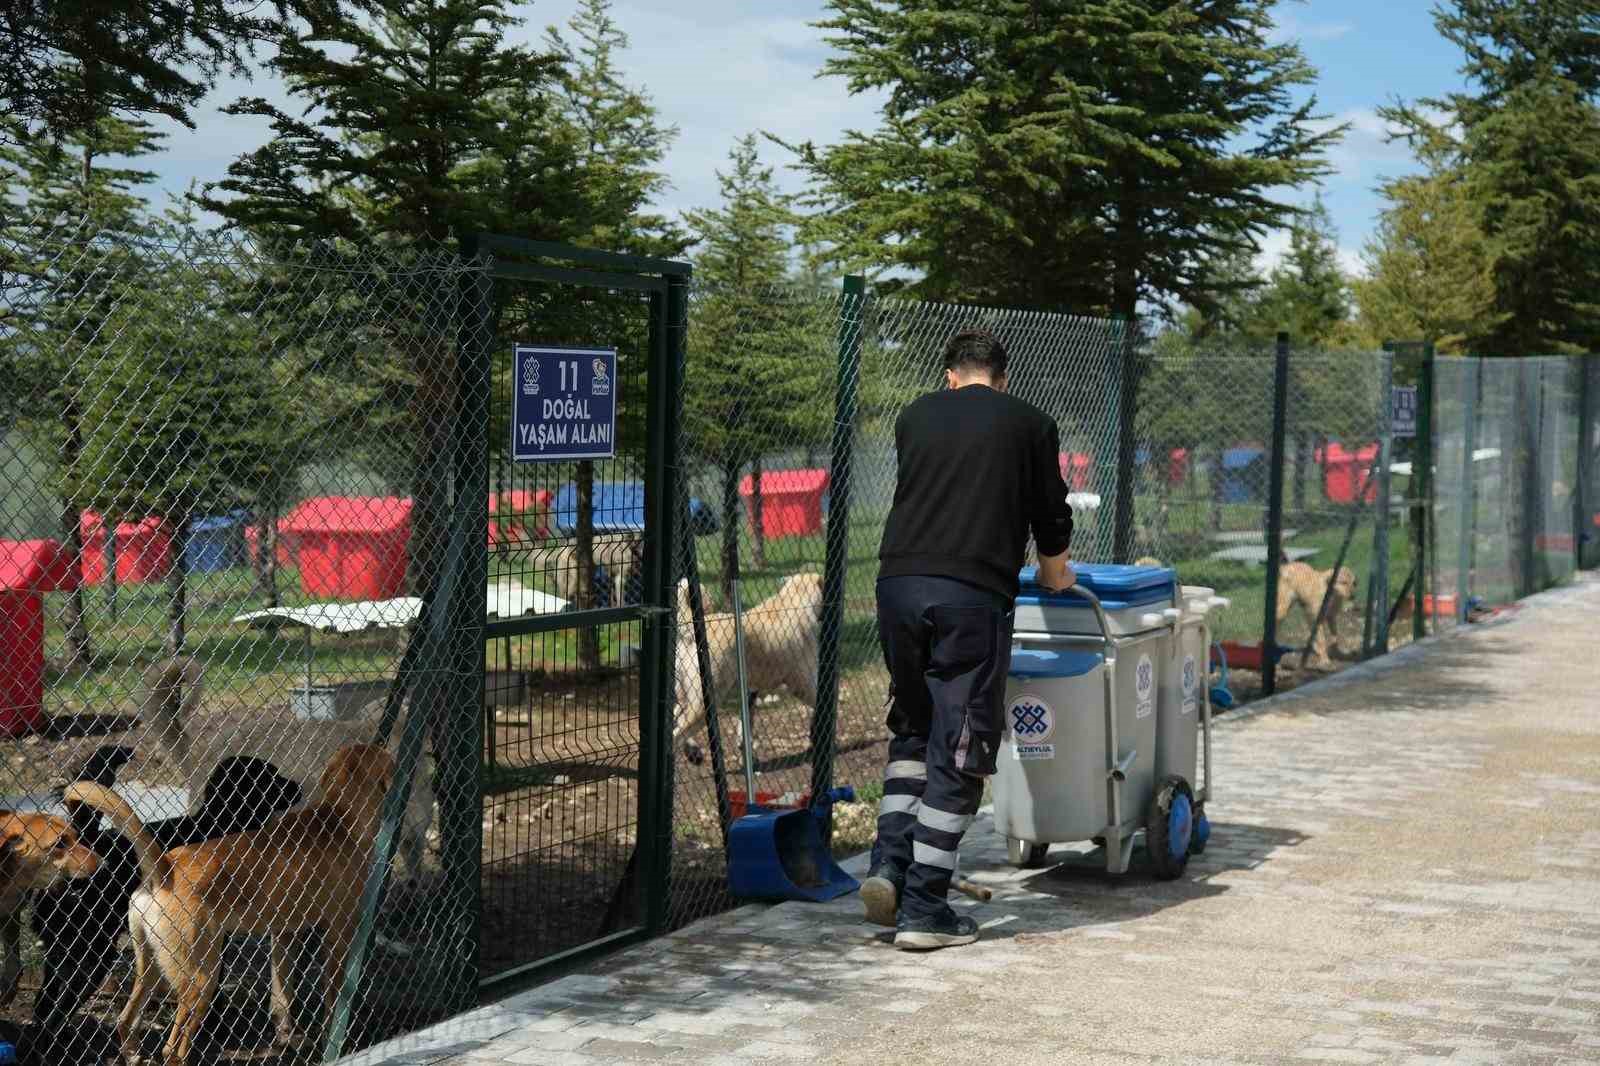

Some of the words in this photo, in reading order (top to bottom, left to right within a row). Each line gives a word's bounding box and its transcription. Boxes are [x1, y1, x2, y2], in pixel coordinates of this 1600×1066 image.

[559, 361, 578, 392] 11
[543, 394, 591, 419] DOĞAL
[519, 423, 567, 450] YAŞAM
[571, 423, 610, 443] ALANI
